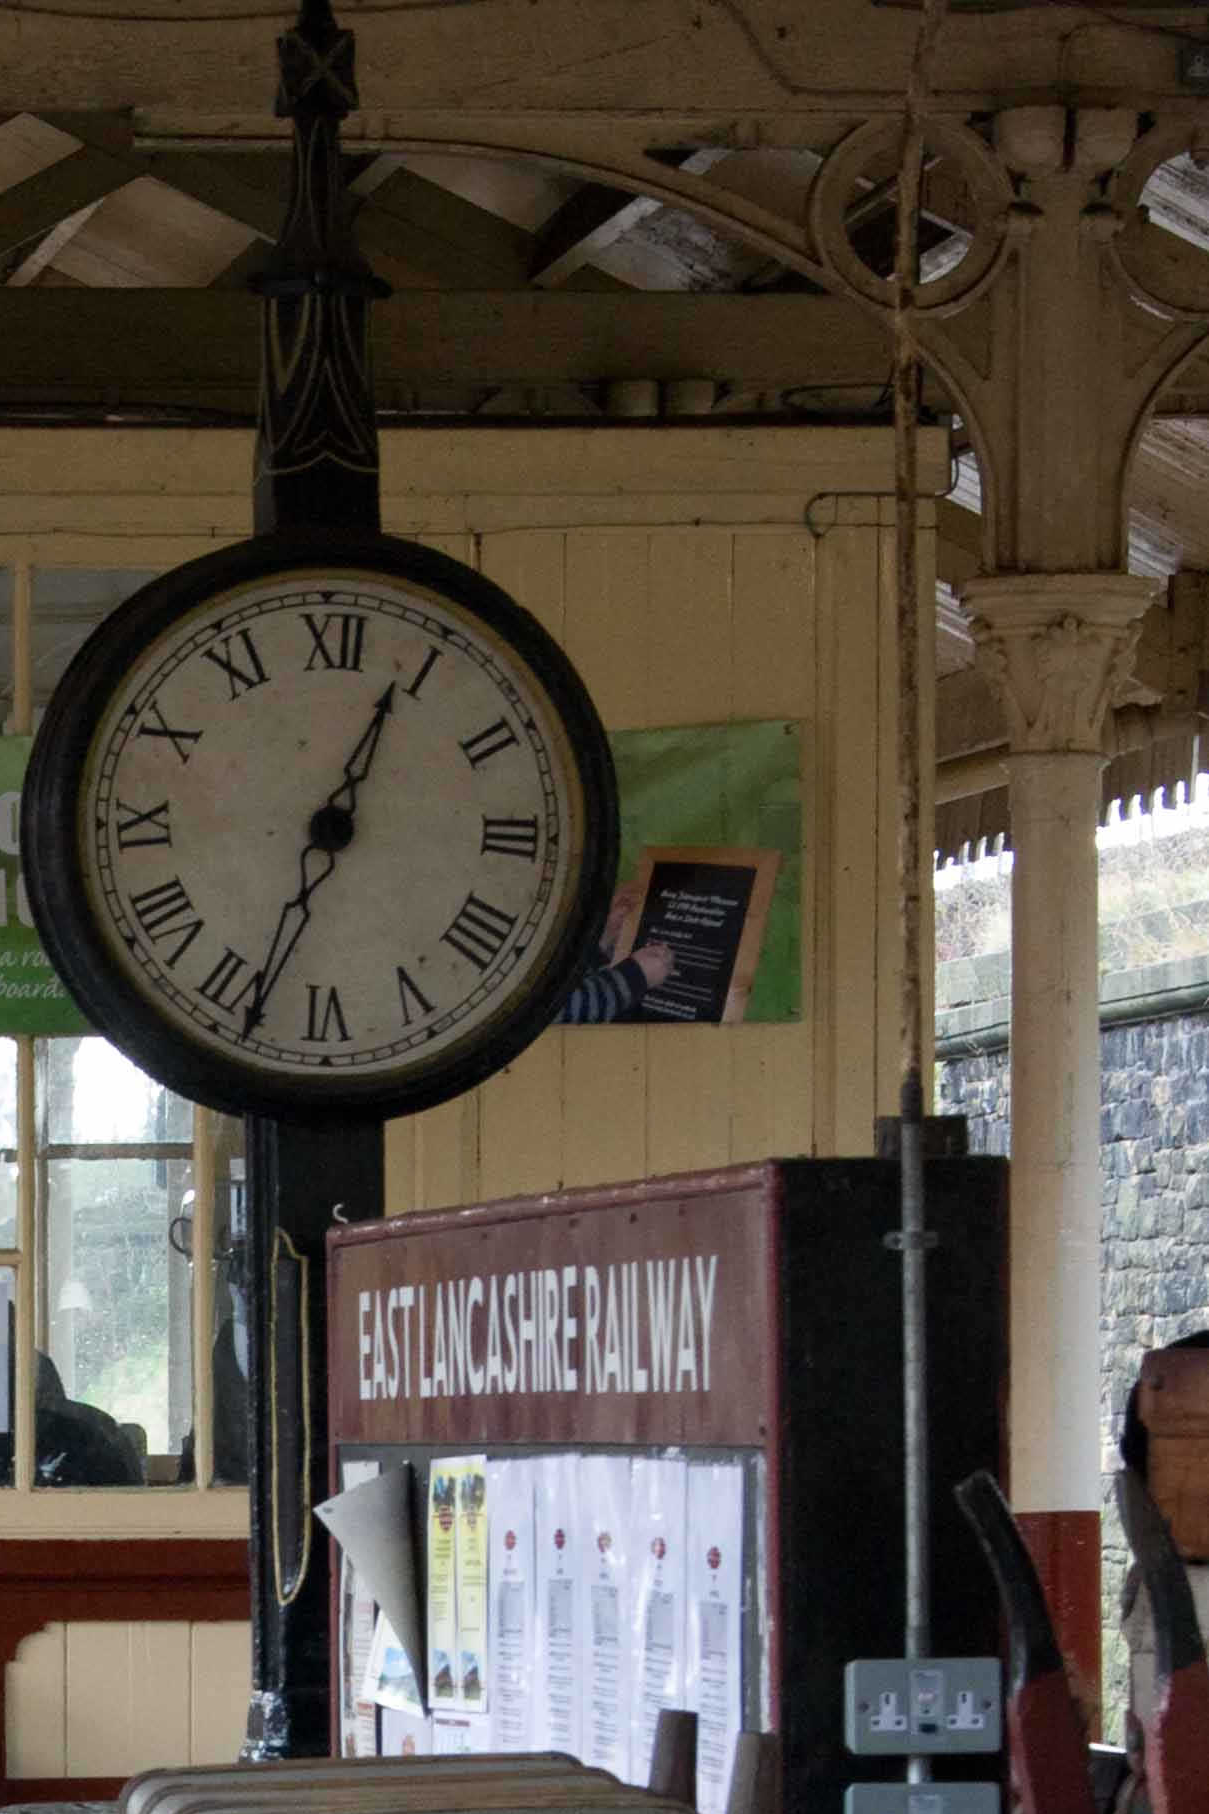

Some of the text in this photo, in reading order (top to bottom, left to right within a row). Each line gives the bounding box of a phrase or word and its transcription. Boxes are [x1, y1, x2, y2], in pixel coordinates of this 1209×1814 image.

[200, 626, 271, 701] XI
[300, 613, 369, 673] XII
[402, 645, 443, 700] I
[136, 701, 203, 764] X
[457, 716, 519, 769] II
[116, 797, 171, 854] IX
[481, 813, 538, 863] III
[130, 875, 205, 970] VIII
[439, 890, 519, 975] IIII
[300, 984, 352, 1042] VI
[396, 965, 437, 1026] V
[359, 1254, 718, 1400] EAST LANCASHIRE RAILWAY
